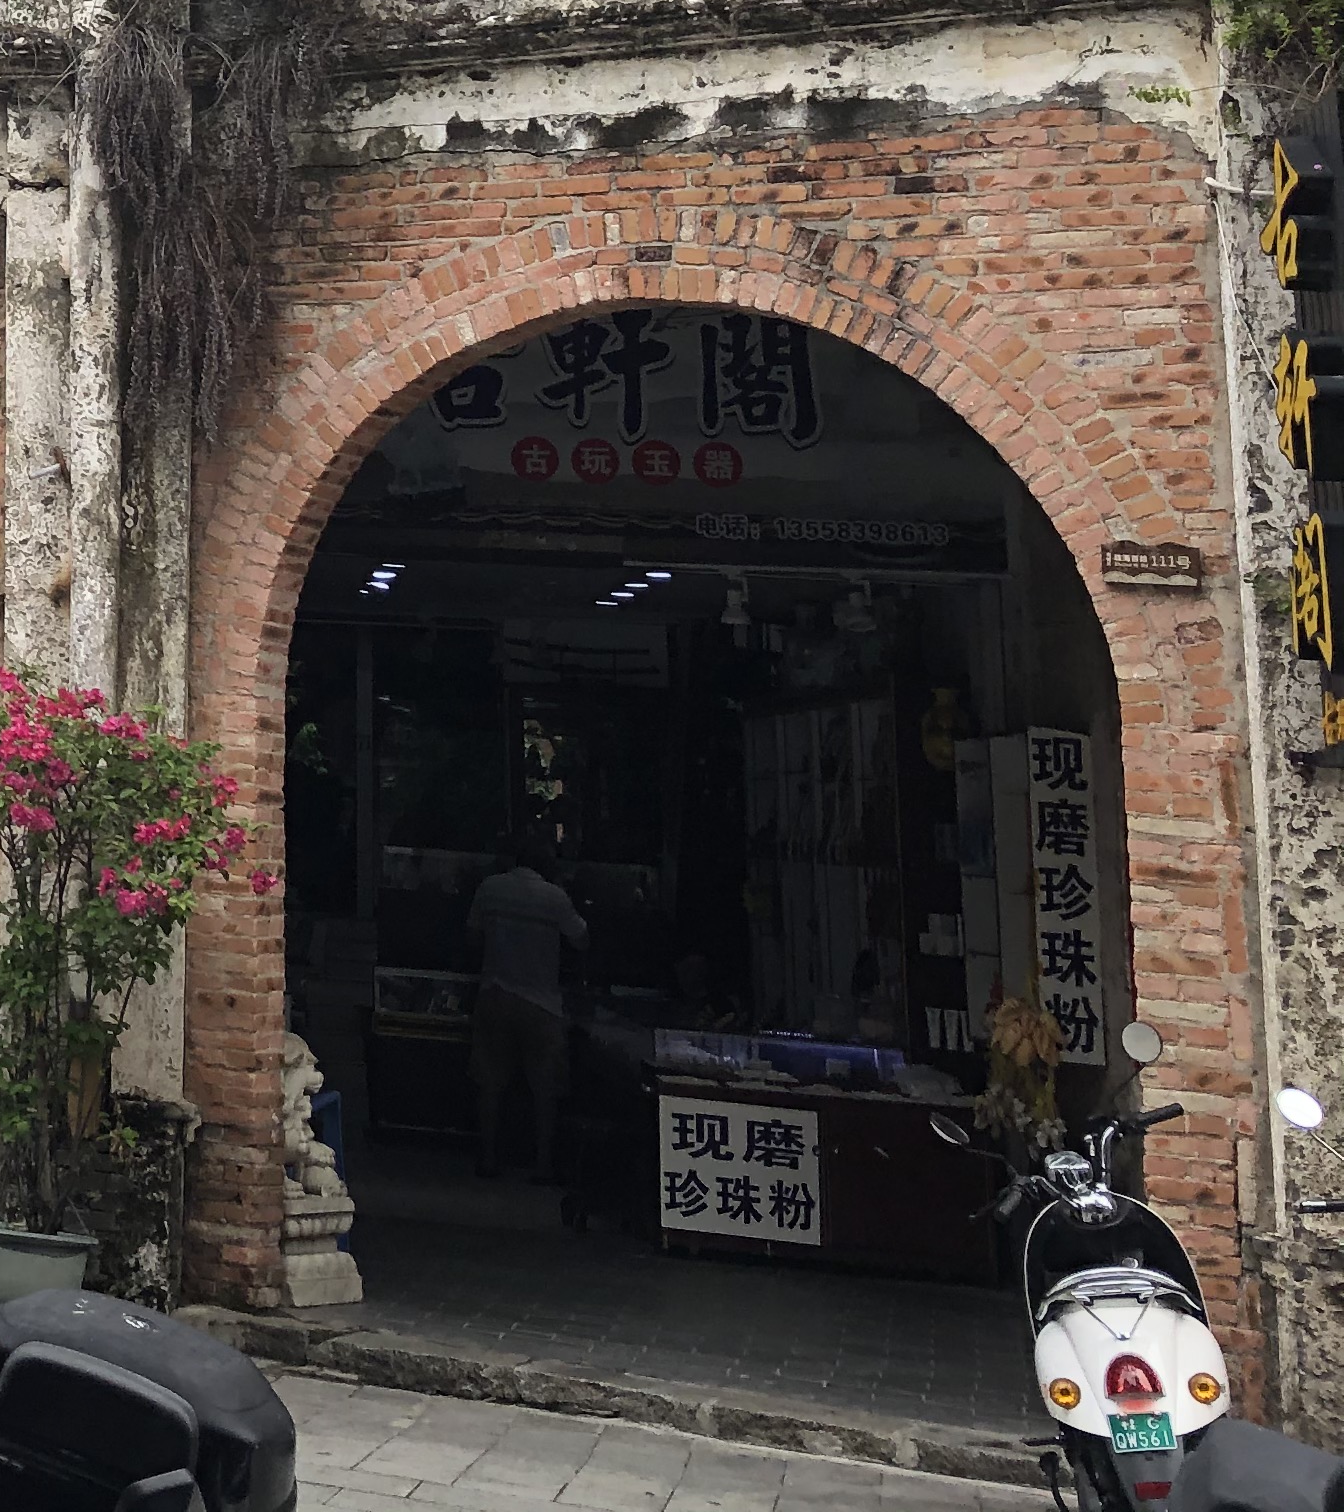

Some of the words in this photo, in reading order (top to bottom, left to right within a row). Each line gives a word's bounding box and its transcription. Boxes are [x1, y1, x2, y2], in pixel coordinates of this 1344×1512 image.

[518, 442, 738, 482] 古玩玉器
[1152, 555, 1192, 570] 111号
[1031, 736, 1099, 1055] 现磨珍珠粉
[671, 1112, 806, 1171] 现磨
[663, 1168, 816, 1231] 珍珠粉
